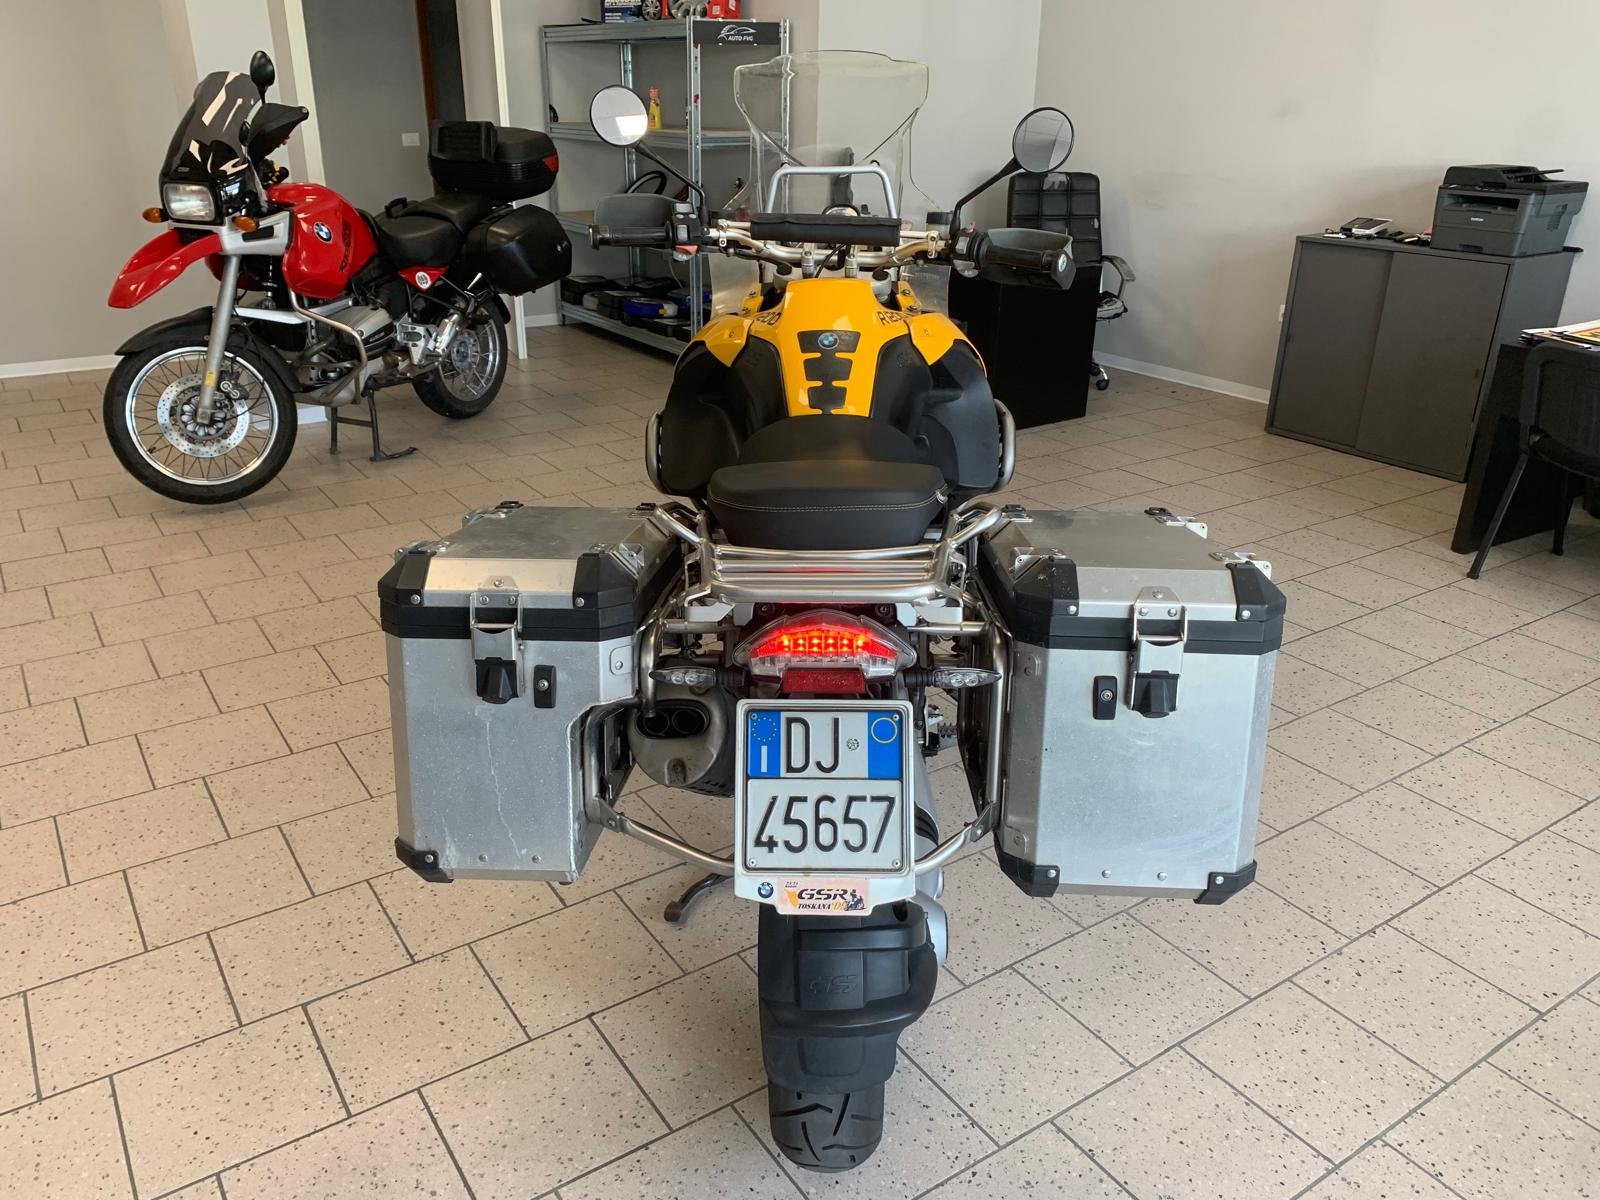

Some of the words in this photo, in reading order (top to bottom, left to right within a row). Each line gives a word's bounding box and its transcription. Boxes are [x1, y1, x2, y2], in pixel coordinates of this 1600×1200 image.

[785, 717, 840, 774] DJ
[754, 795, 896, 853] 45657
[797, 888, 849, 901] GSR
